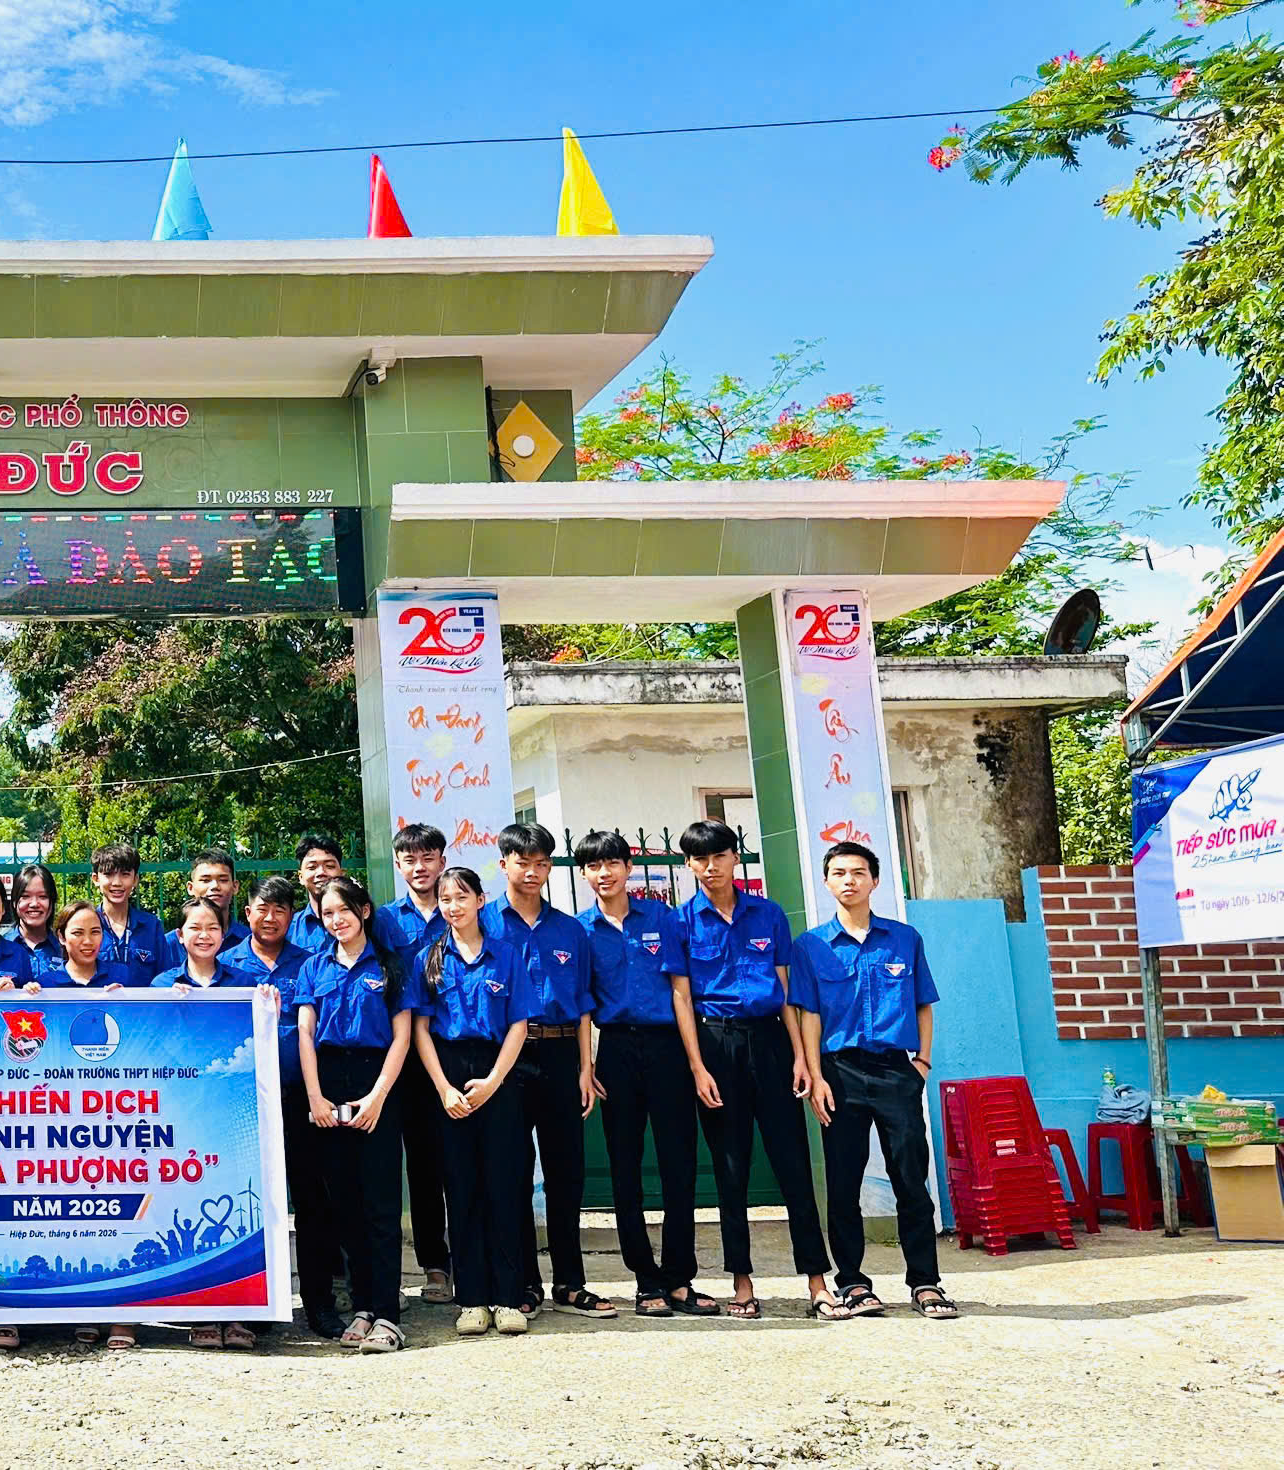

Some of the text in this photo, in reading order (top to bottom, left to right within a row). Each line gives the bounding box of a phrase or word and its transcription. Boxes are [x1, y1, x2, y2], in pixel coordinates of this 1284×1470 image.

[25, 394, 83, 428] PHỔ
[94, 399, 189, 429] THÔNG
[196, 488, 334, 504] ĐT. 02353 883 227
[64, 530, 203, 585] ĐÀO
[398, 607, 484, 656] 20
[795, 604, 860, 645] 20
[819, 820, 872, 844] Khoa
[1176, 817, 1277, 857] TIẾP SỨC MÙA
[7, 1066, 30, 1079] ĐỨC
[44, 1066, 74, 1079] ĐOÀN
[77, 1065, 120, 1079] TRƯỜNG
[123, 1067, 150, 1079] THPT
[152, 1065, 175, 1080] HIỆP
[177, 1065, 199, 1079] ĐỨC
[82, 1089, 159, 1120] DỊCH
[47, 1119, 175, 1154] NGUYỆN
[17, 1155, 149, 1190] PHƯỢNG
[13, 1196, 122, 1216] NĂM 2026
[9, 1230, 27, 1239] Hiệp
[48, 1229, 71, 1239] tháng
[72, 1230, 78, 1238] 6
[79, 1230, 96, 1238] năm
[98, 1229, 118, 1237] 2026
